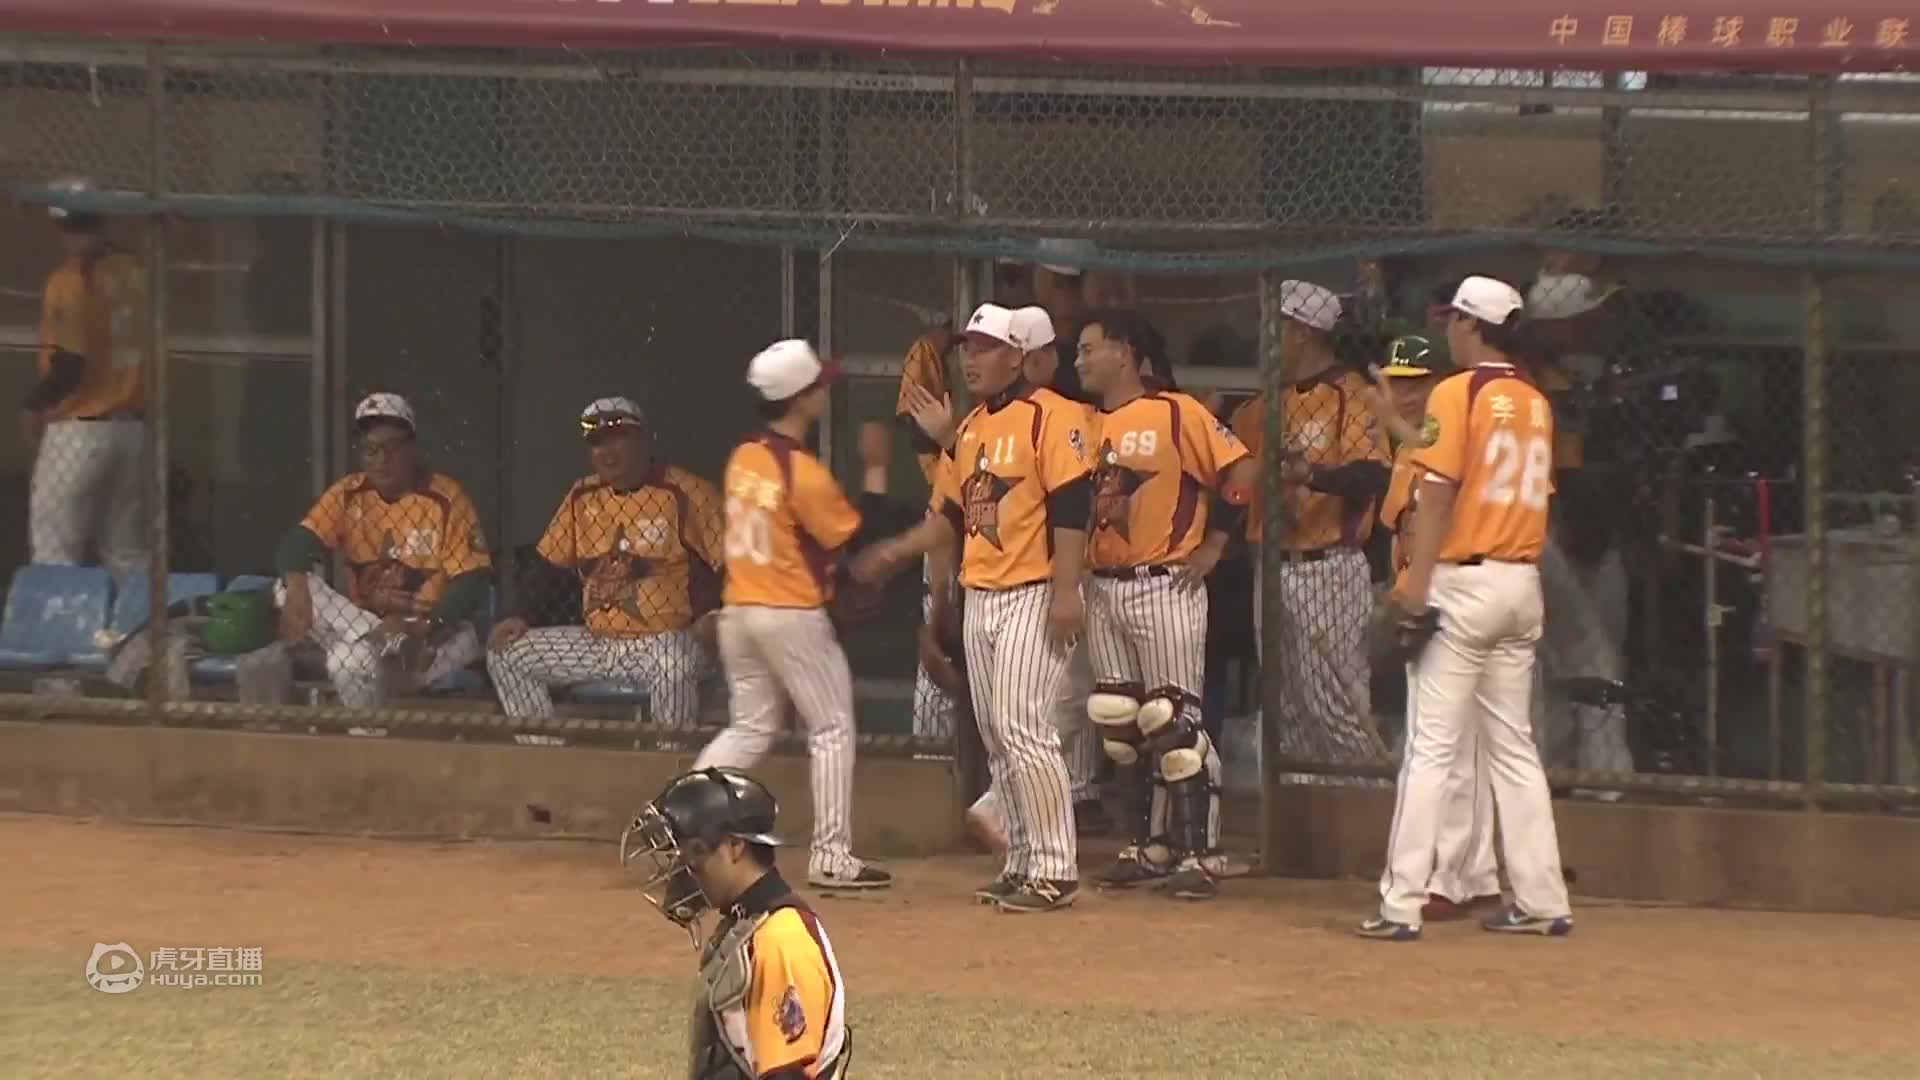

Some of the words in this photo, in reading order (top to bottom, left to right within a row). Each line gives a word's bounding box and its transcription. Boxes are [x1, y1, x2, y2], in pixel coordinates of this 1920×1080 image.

[1549, 14, 1911, 48] 中国棒球职业联
[992, 434, 1016, 465] 11
[1120, 429, 1157, 457] 69
[1482, 429, 1551, 512] 28
